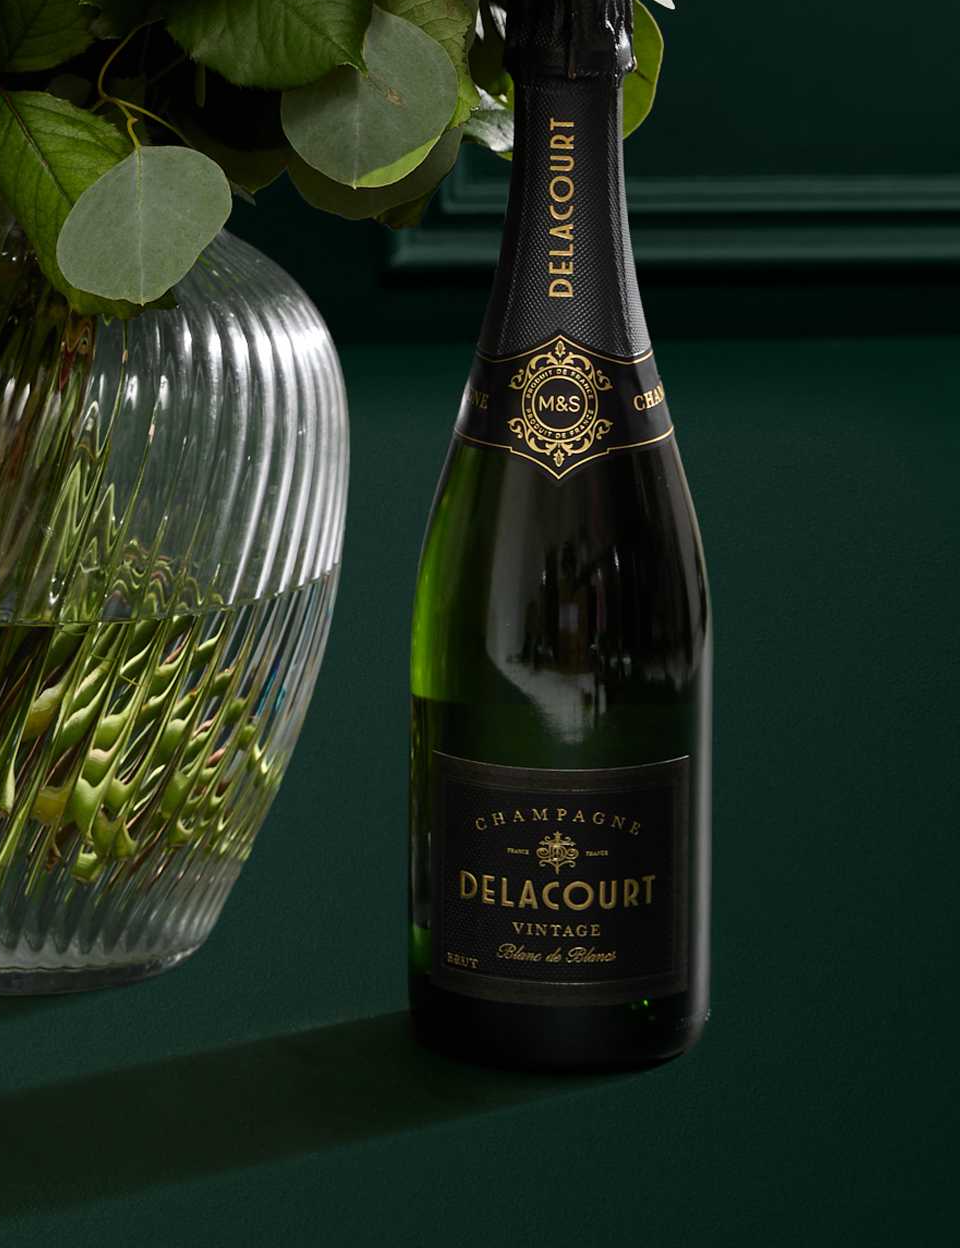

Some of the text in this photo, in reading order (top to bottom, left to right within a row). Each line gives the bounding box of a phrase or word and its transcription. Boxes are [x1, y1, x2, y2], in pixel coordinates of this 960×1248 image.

[548, 117, 576, 298] DELACOURT
[525, 369, 553, 399] PRODUIT
[570, 371, 594, 400] FRANCE
[538, 395, 581, 413] M&S
[525, 408, 553, 438] PRODUIT
[569, 409, 594, 437] FRANCE
[474, 808, 641, 836] CHAMPAGNE
[459, 870, 656, 911] DELACOURT
[512, 921, 601, 937] VINTAGE
[447, 952, 481, 969] BRUT
[496, 943, 617, 964] Blanc de Blancs
